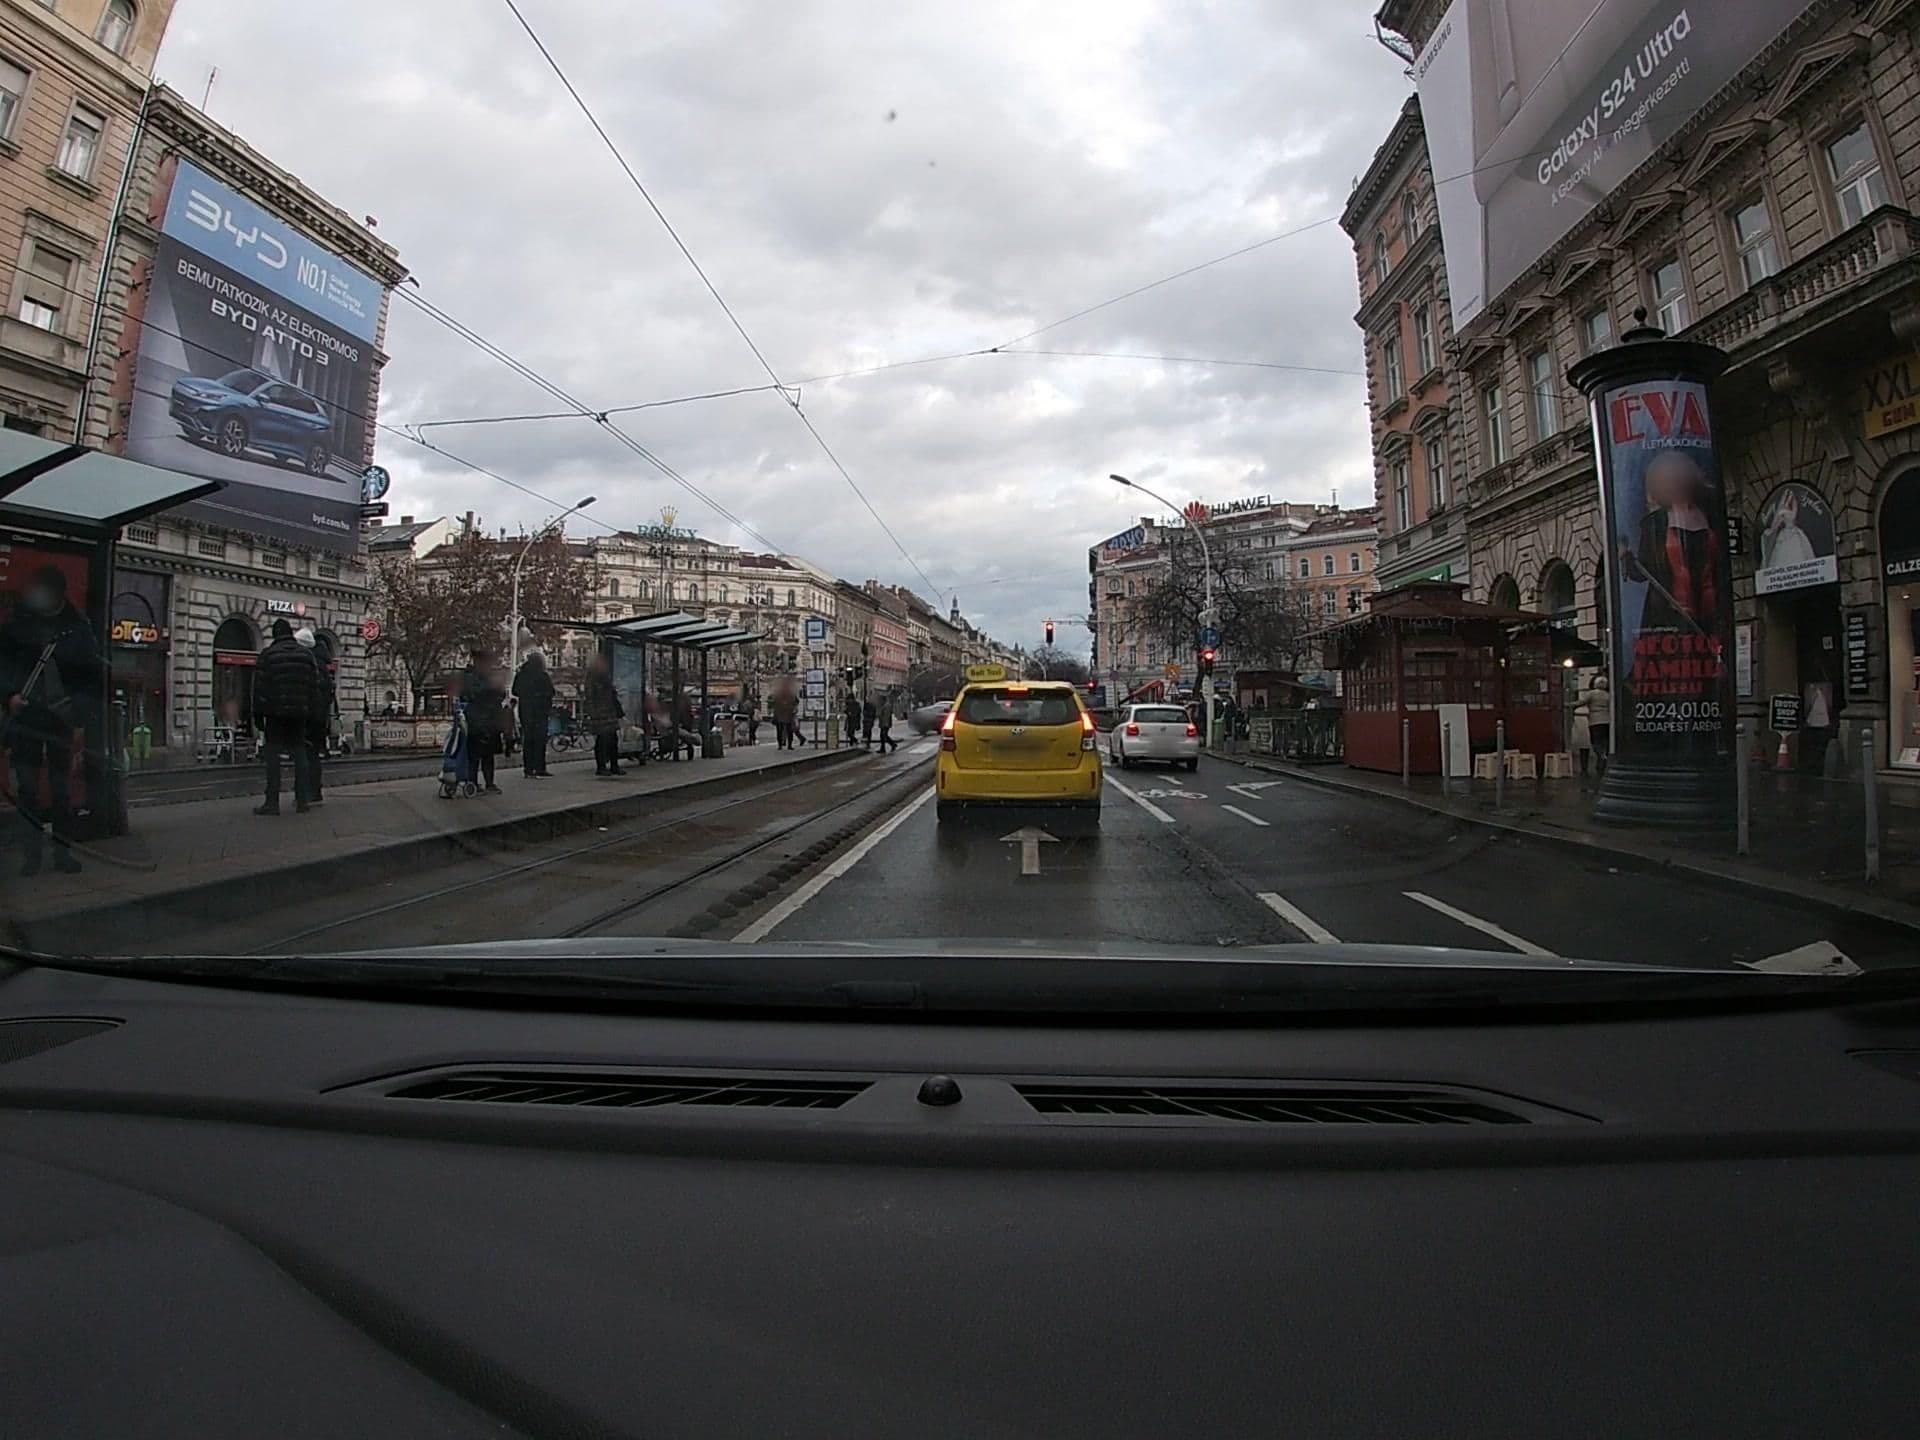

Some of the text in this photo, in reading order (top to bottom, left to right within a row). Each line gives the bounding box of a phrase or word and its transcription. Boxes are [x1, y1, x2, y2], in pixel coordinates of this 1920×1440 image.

[1419, 21, 1452, 79] SAMSUNG
[1537, 8, 1692, 185] Galaxy S24 Ultra
[1558, 162, 1592, 198] Galaxy
[1612, 57, 1692, 143] megérkezett!
[185, 188, 288, 270] BYD
[297, 255, 328, 296] NO.1
[177, 258, 359, 362] BEMUTATKOZIK AZ ELEKTROMOS
[211, 298, 330, 366] BYD ATTO 3
[1610, 390, 1708, 444] ÉVA
[1211, 494, 1271, 517] HUAWEI
[268, 599, 296, 613] PIZZA
[1635, 719, 1723, 733] BUDAPEST ARÉNA
[1775, 699, 1800, 709] EROTIC
[1776, 708, 1796, 717] SHOP
